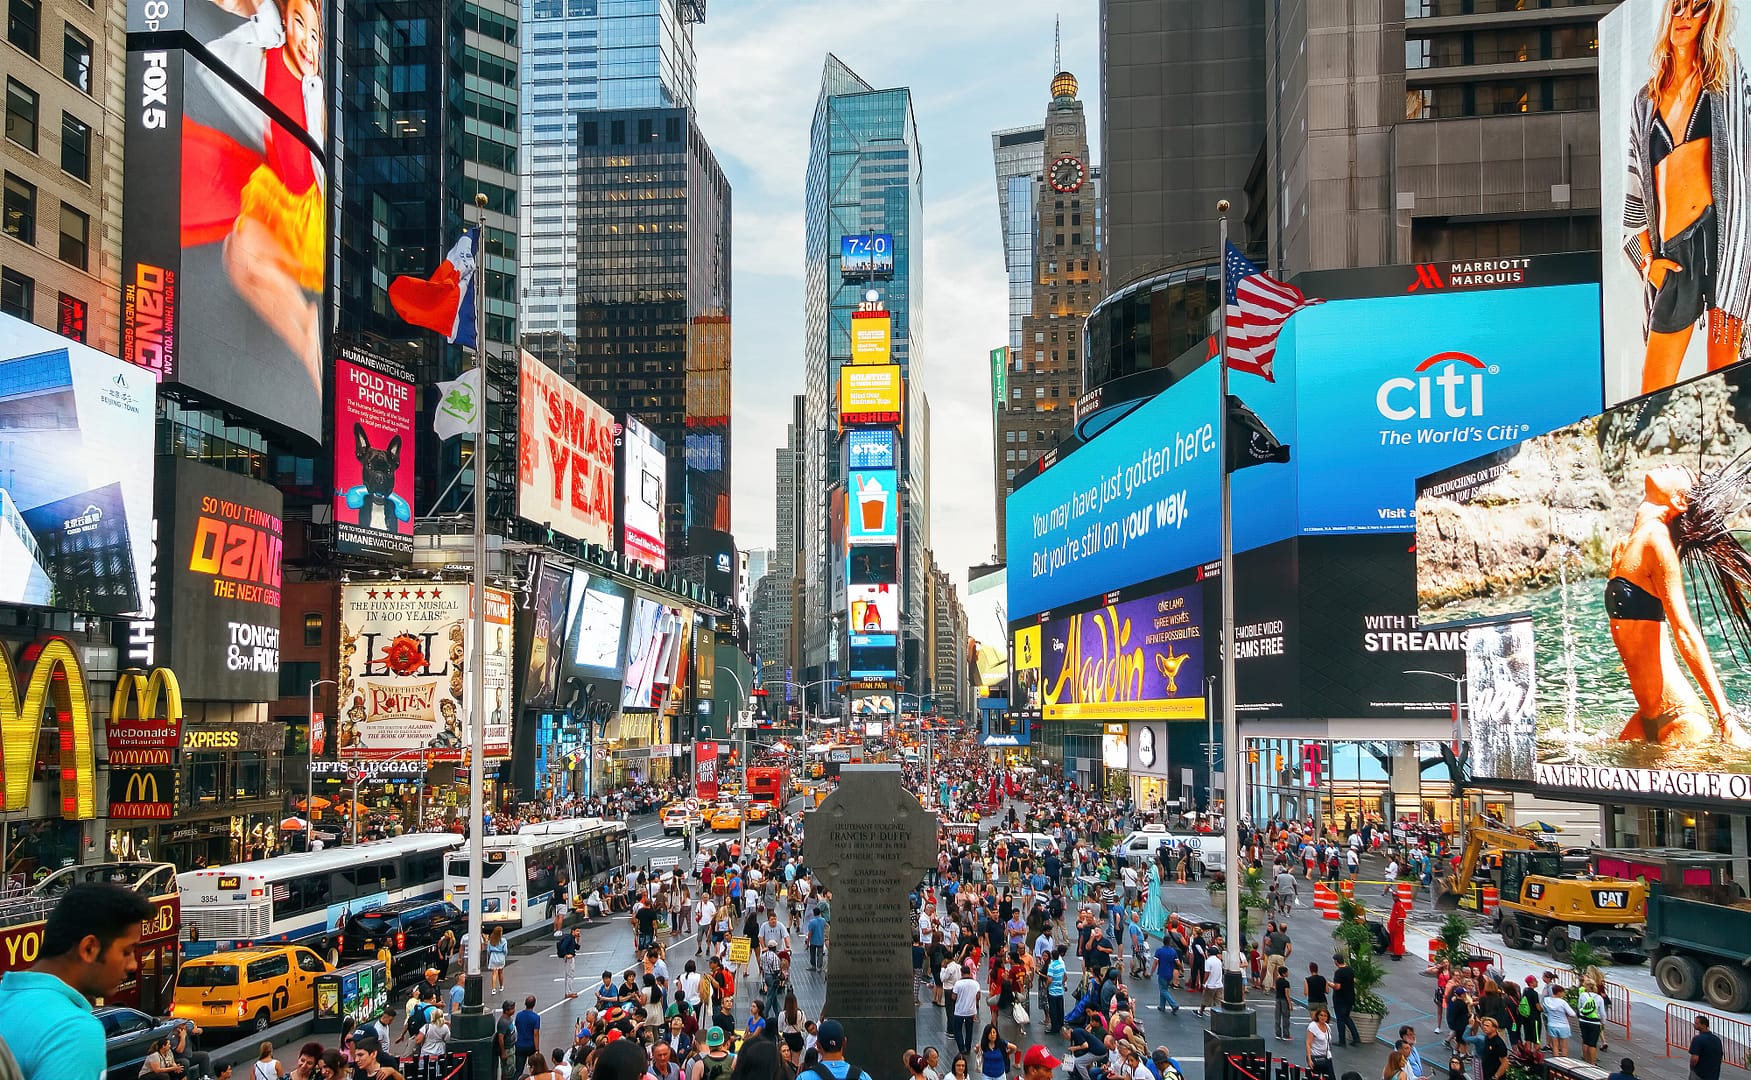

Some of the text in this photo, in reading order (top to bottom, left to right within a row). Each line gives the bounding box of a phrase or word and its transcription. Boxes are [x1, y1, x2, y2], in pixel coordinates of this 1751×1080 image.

[143, 51, 167, 129] FOX 5
[848, 238, 886, 255] 7:40
[1451, 258, 1532, 274] MARRIOTT
[1451, 271, 1522, 286] MARQUIS
[165, 285, 174, 306] YOU
[858, 302, 884, 312] 2016
[164, 305, 175, 333] THINK
[164, 334, 174, 353] YOU
[163, 354, 173, 375] CAN
[342, 348, 415, 383] HUMANEWATCH.ORG
[350, 368, 408, 400] HOLD THE
[359, 386, 400, 412] PHONE
[842, 413, 899, 422] TOSHIBA
[1379, 430, 1412, 446] The
[1417, 426, 1483, 444] World's
[1032, 423, 1216, 539] You may have just gotten here.
[1433, 472, 1476, 497] RETOUCHING
[1476, 471, 1489, 482] ON
[202, 496, 218, 514] SO
[220, 501, 241, 520] YOU
[244, 506, 270, 530] THINK
[1378, 508, 1408, 519] Visit
[338, 531, 413, 553] HUMANEWATCH.ORG
[1032, 489, 1188, 578] But you're still on your way.
[214, 579, 236, 598] THE
[236, 585, 263, 603] NEXT
[350, 601, 459, 611] THE FUNNIEST MUSICAL
[1158, 601, 1169, 613] ONE
[366, 612, 402, 621] IN 400
[1364, 615, 1405, 629] WITH
[228, 622, 279, 650] TONIGHT
[1235, 619, 1283, 639] T-MOBILE VIDEO
[1043, 605, 1145, 704] Aladdin
[1260, 637, 1284, 656] FREE
[253, 647, 273, 672] FOX
[109, 727, 177, 739] McDonald's
[307, 761, 348, 773] GIFTS
[1539, 766, 1640, 792] AMERICAN
[1648, 770, 1722, 798] EAGLE
[830, 832, 868, 841] FRANCIS
[880, 832, 911, 841] DUFFY
[1598, 891, 1623, 908] CAT
[142, 920, 160, 936] BUS
